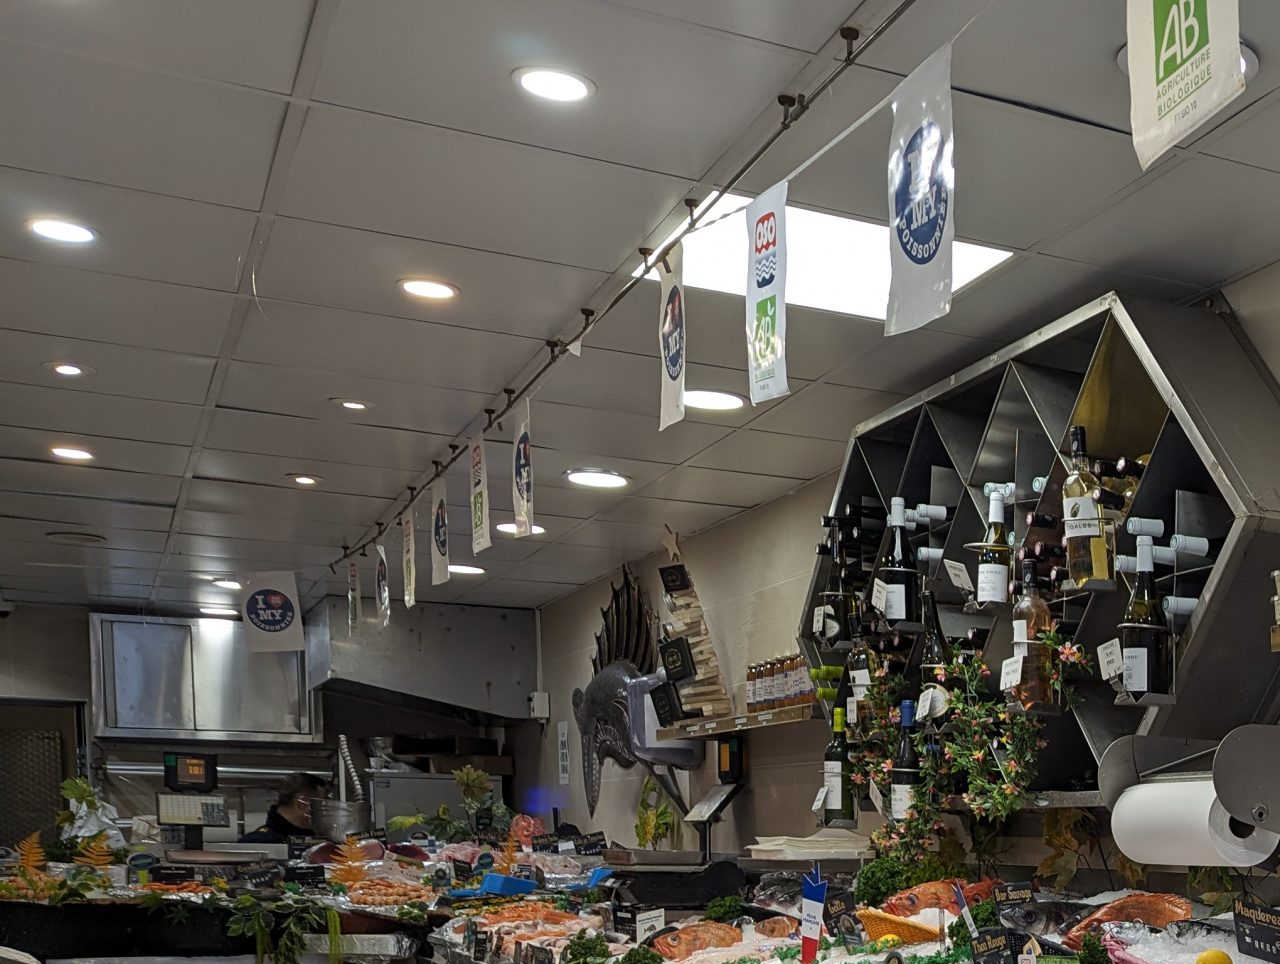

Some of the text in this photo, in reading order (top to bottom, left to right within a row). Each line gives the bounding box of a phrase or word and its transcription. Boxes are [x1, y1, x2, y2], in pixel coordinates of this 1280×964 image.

[1159, 0, 1199, 79] AB
[1157, 48, 1211, 100] AGRICULTURE
[1157, 64, 1212, 116] BIOLOGIQUE
[910, 184, 938, 230] MY
[756, 216, 776, 249] OSO
[255, 595, 266, 608] I
[258, 609, 282, 620] MY
